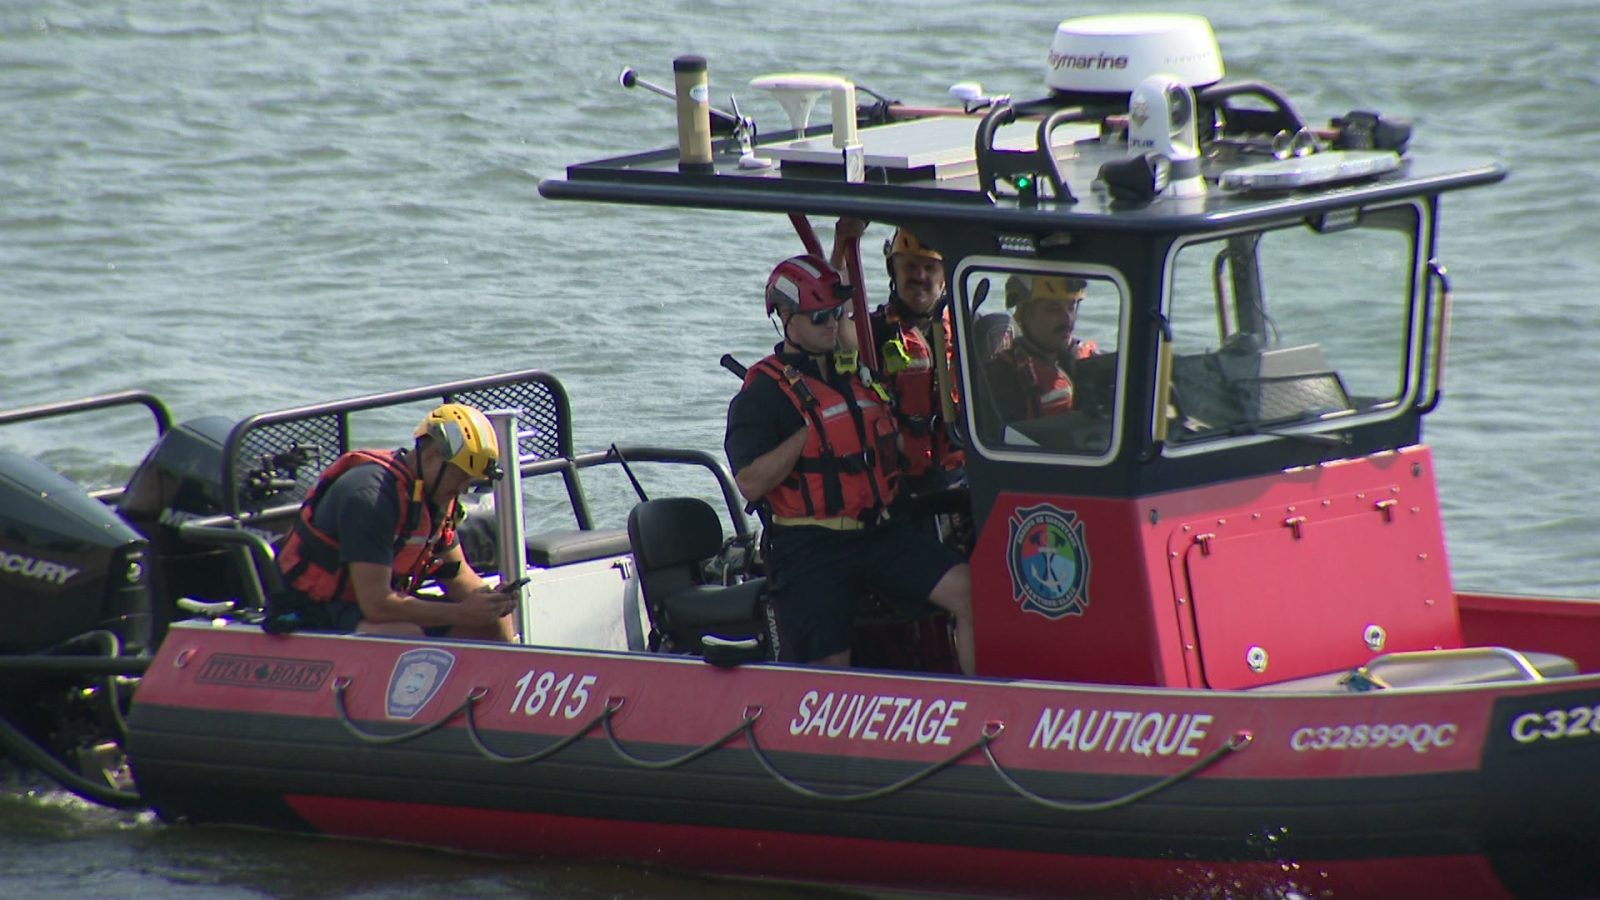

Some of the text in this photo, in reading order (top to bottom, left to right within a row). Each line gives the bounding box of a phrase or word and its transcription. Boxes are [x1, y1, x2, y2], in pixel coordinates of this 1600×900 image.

[204, 659, 328, 687] TITAN BOATS
[510, 670, 597, 719] 1815
[788, 690, 1214, 757] SAUVETAGE NAUTIQUE
[1290, 722, 1457, 753] C32899QC
